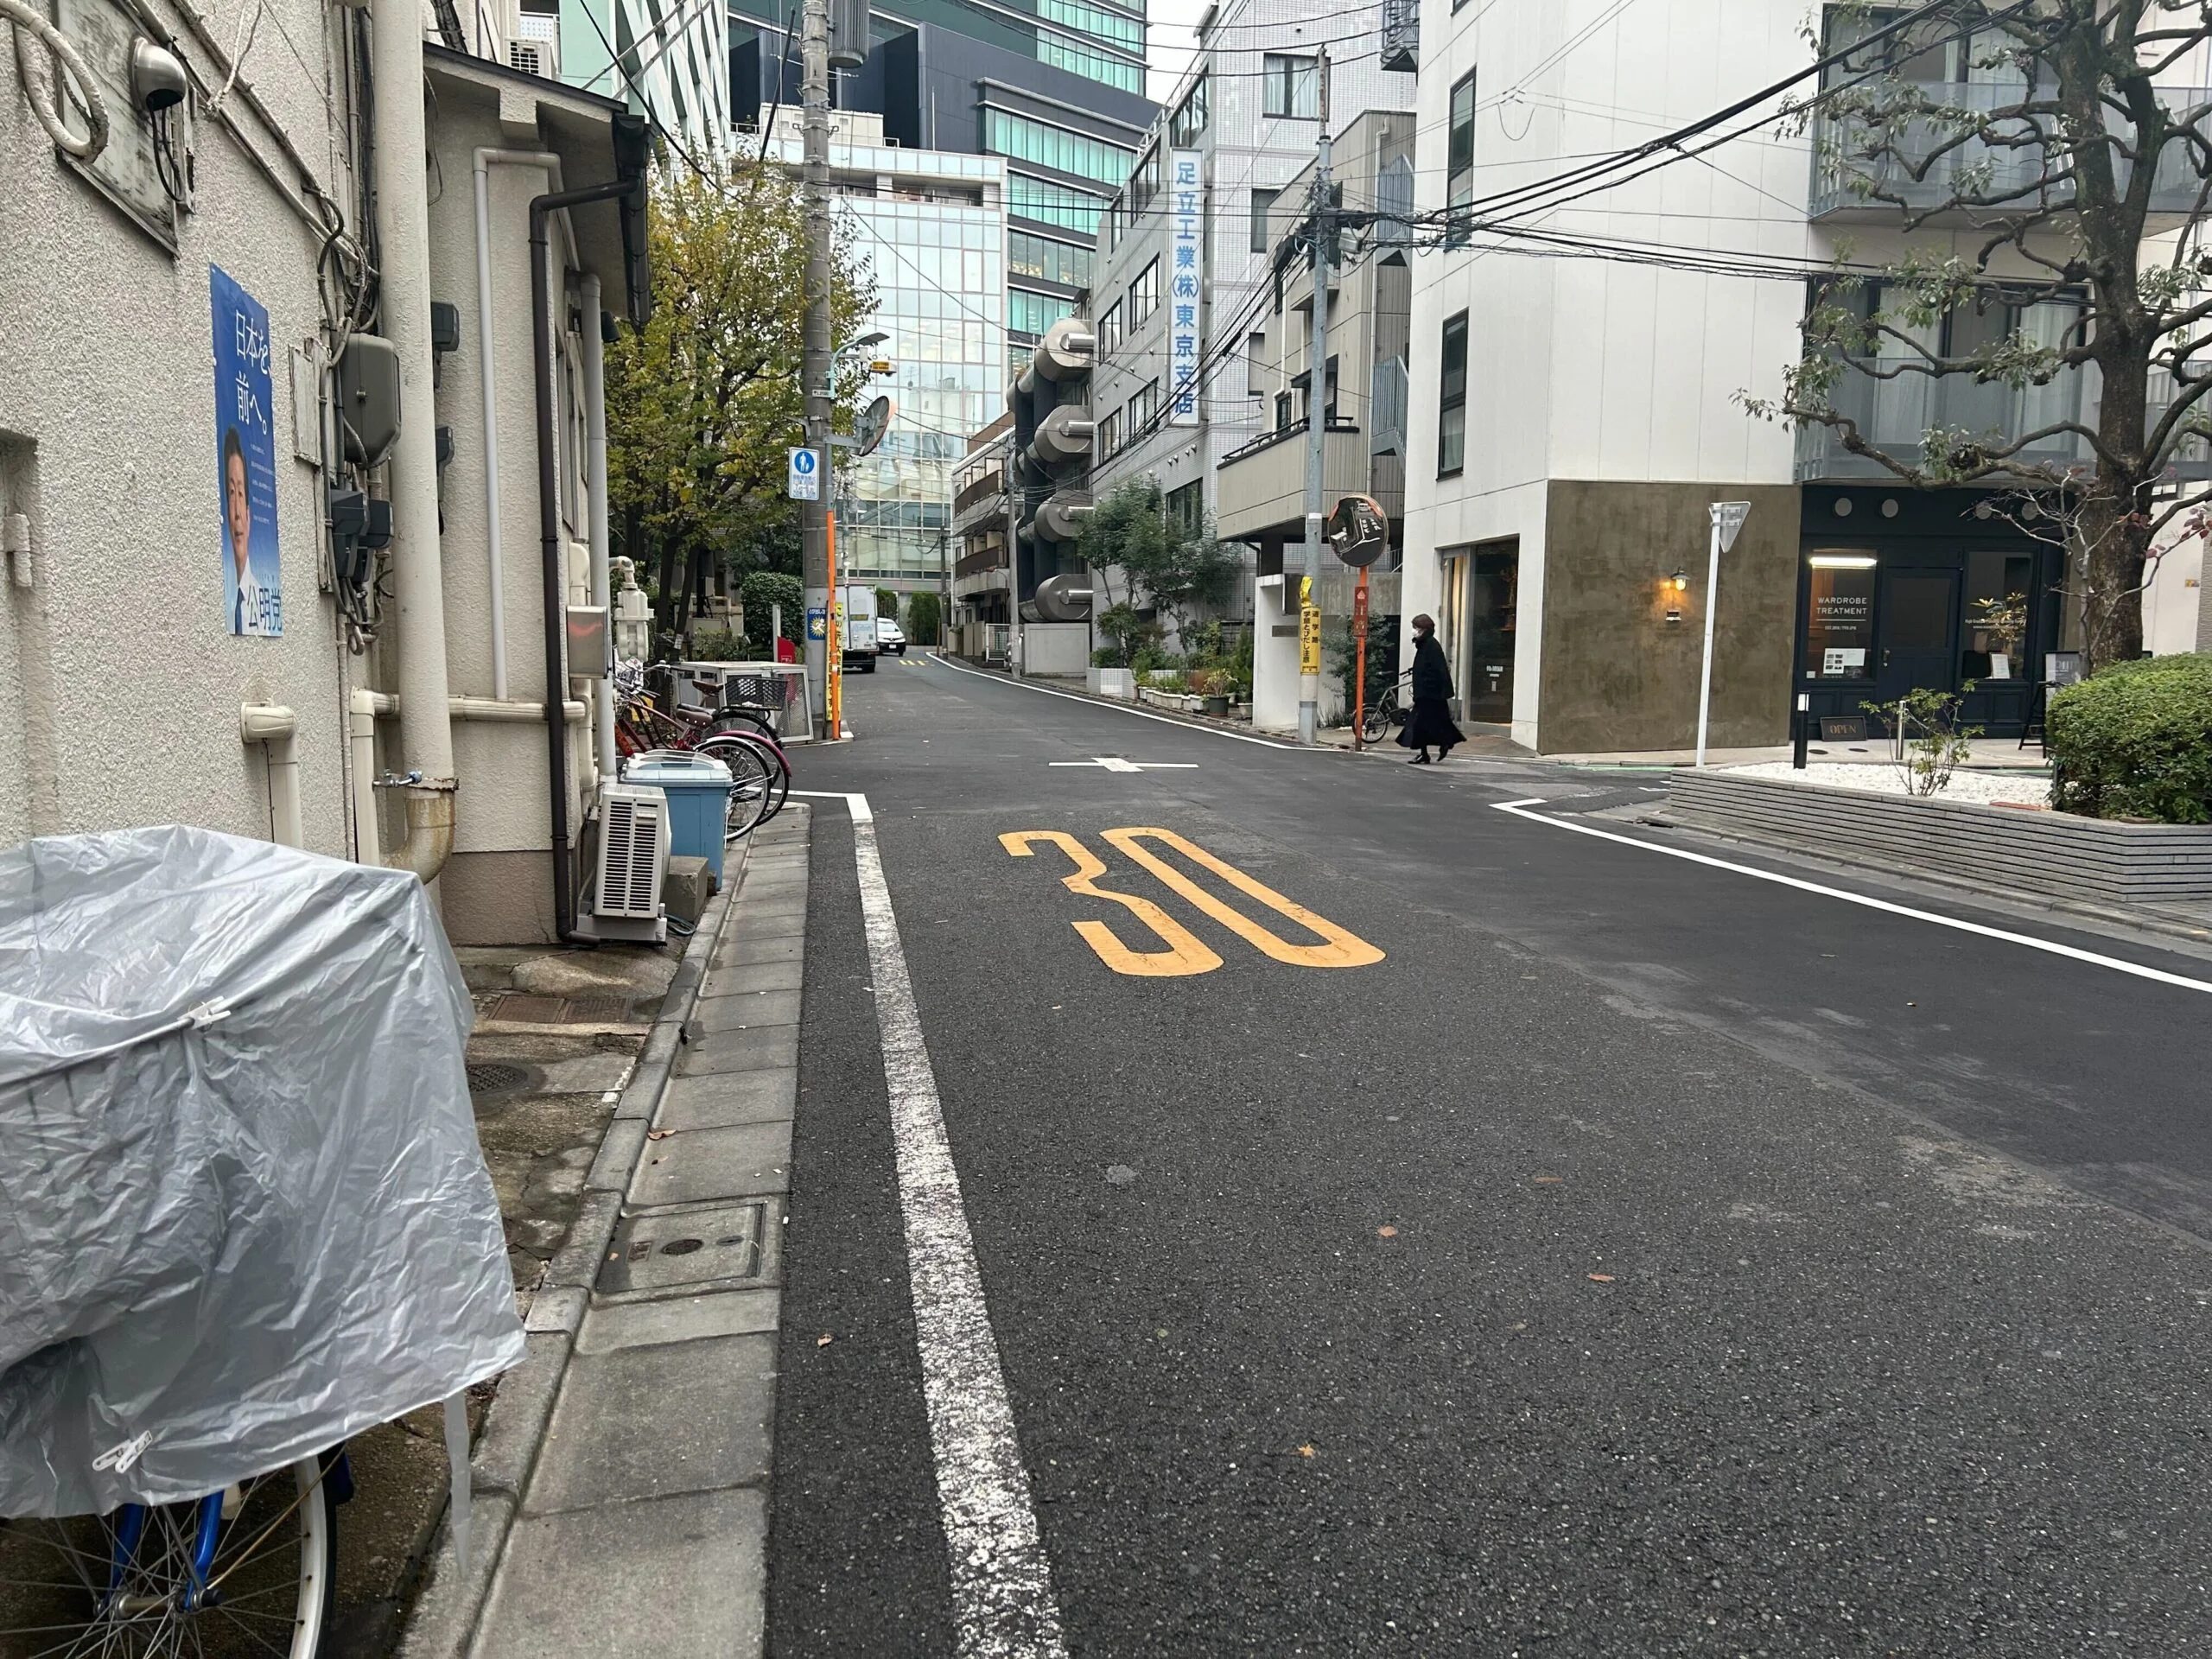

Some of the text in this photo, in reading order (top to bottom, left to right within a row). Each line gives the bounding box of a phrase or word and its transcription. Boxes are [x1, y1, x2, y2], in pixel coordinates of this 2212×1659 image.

[1172, 162, 1199, 414] 足立工業(株)東京支店
[235, 371, 268, 435] 前へ。
[247, 585, 283, 632] 公明党
[1829, 725, 1857, 734] OPEN
[997, 827, 1387, 976] 30
